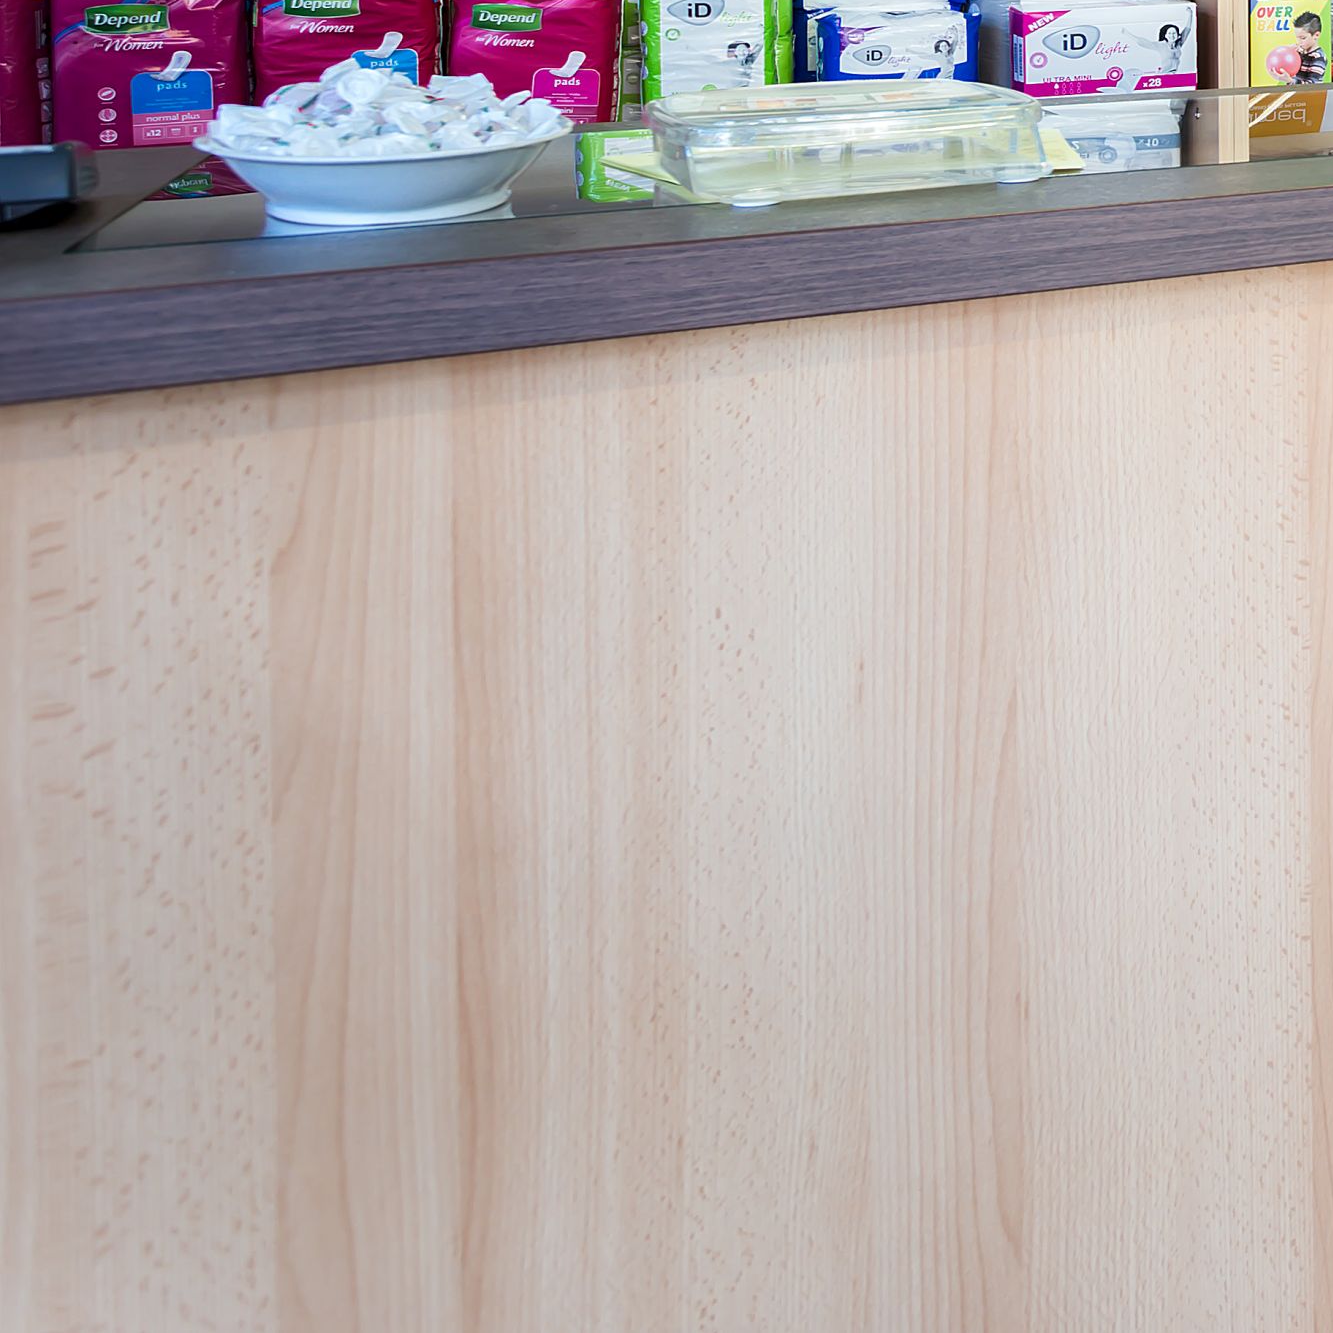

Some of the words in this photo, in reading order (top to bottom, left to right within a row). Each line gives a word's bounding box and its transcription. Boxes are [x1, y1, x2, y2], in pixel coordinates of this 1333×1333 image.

[687, 3, 712, 18] iD
[1257, 6, 1292, 17] OVER
[94, 11, 161, 28] Depend
[478, 11, 536, 24] Depend
[1028, 13, 1055, 31] NEW
[298, 20, 354, 35] Women
[1257, 19, 1290, 32] BALL
[104, 37, 164, 52] Women
[484, 33, 536, 48] Women
[1062, 33, 1088, 51] iD
[1095, 42, 1129, 62] light
[865, 49, 883, 62] iD
[157, 80, 188, 92] pads
[554, 77, 581, 87] pads
[1143, 77, 1162, 87] x28
[146, 113, 179, 123] normal
[181, 112, 200, 122] plus
